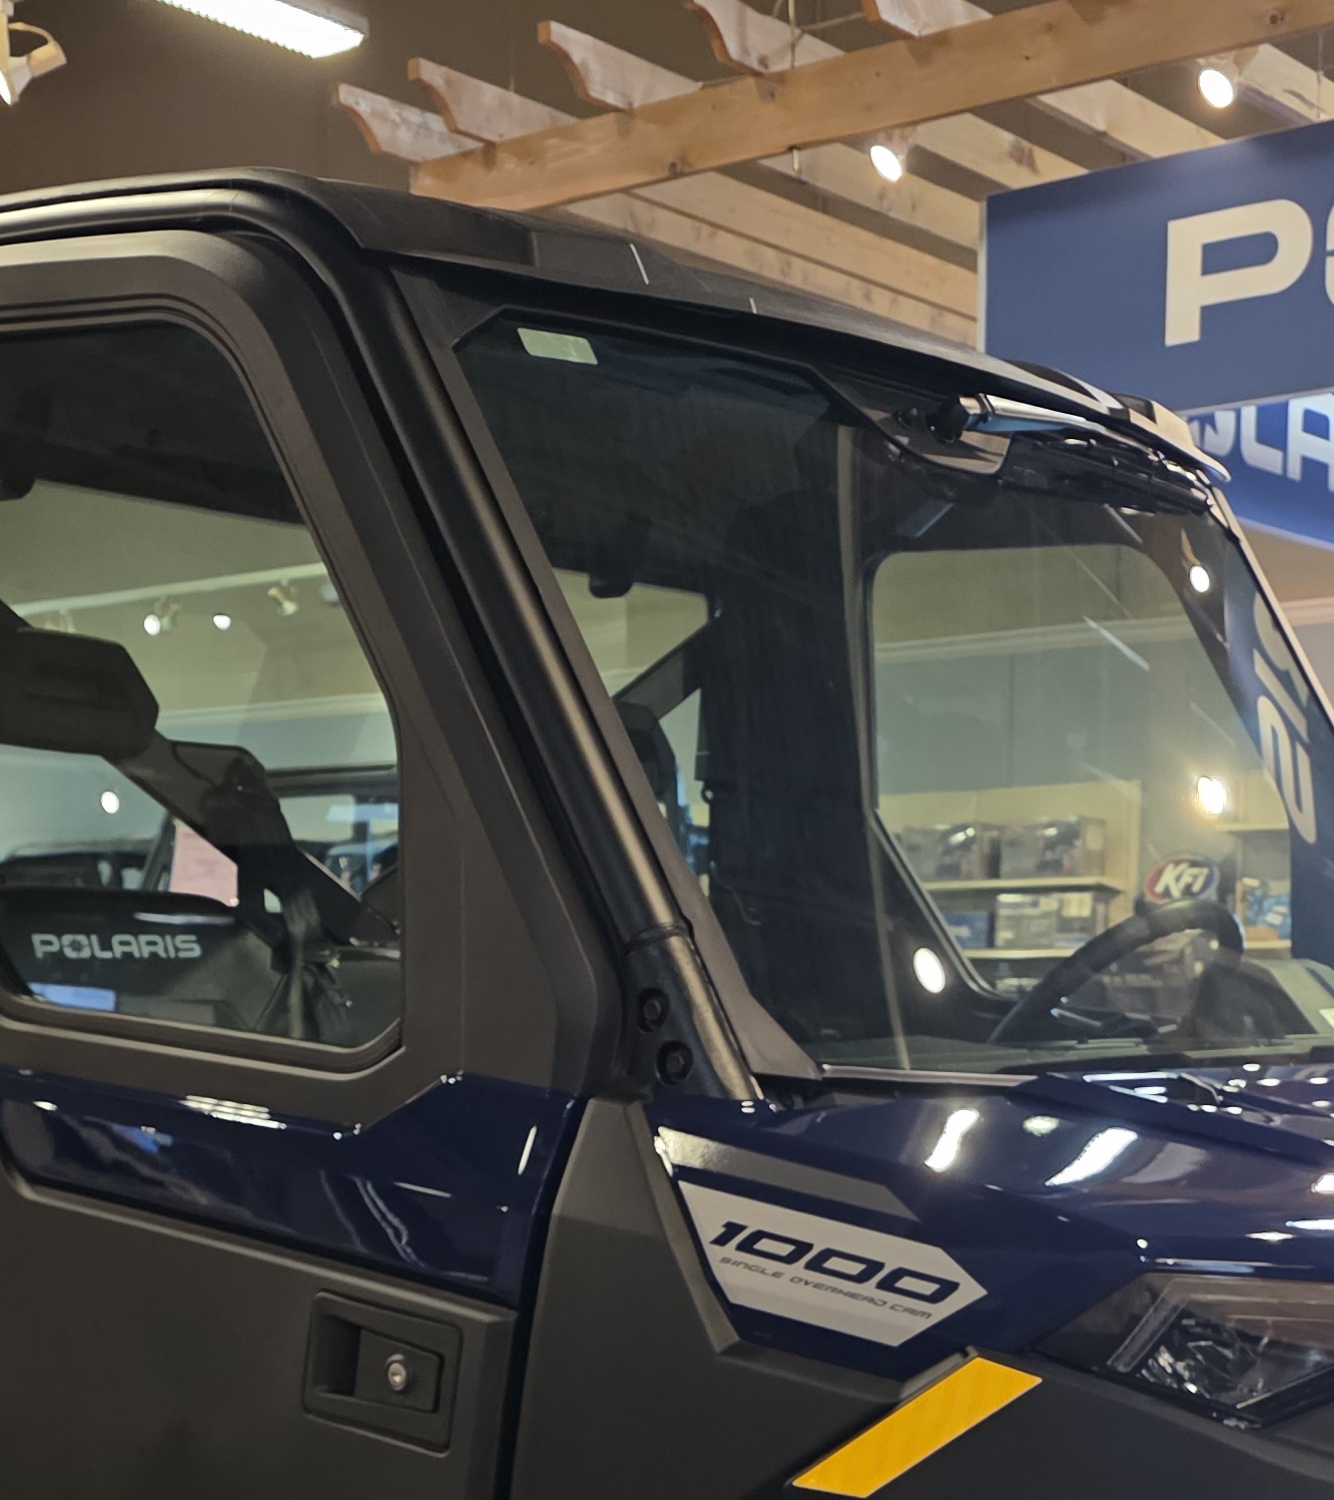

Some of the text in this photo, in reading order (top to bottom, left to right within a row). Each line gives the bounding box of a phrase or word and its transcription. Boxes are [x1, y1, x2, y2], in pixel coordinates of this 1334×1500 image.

[30, 932, 202, 960] POLARIS
[708, 1220, 961, 1305] 1000
[718, 1256, 933, 1320] SINGLE OVERHEAD CAM
